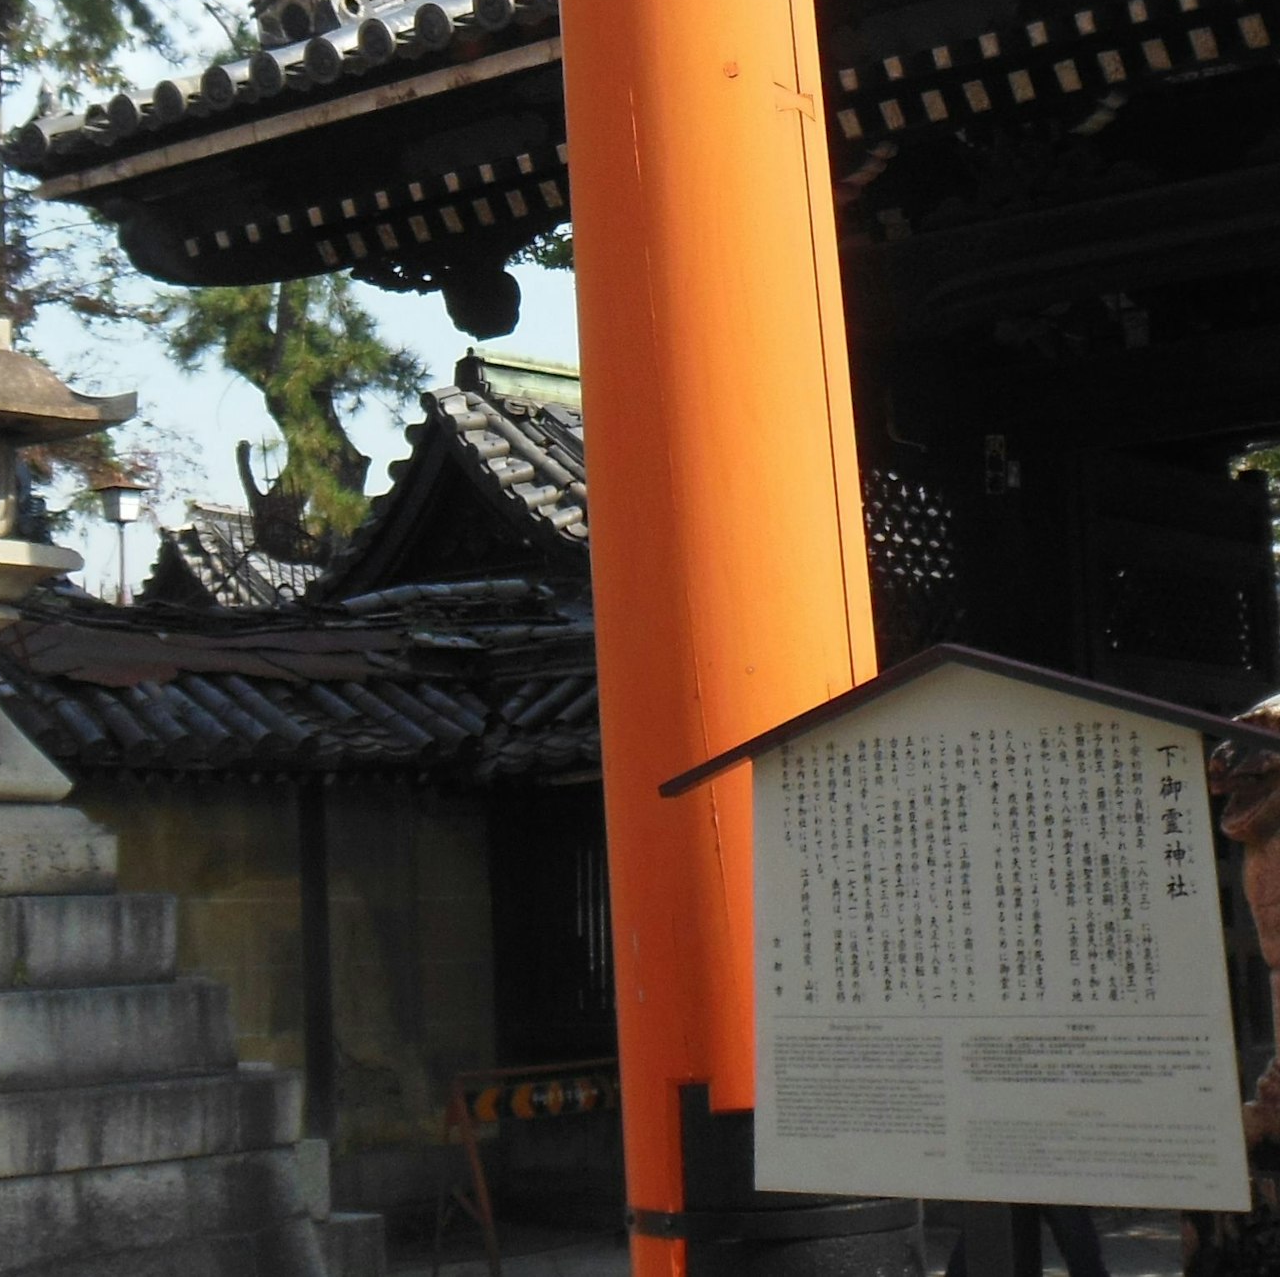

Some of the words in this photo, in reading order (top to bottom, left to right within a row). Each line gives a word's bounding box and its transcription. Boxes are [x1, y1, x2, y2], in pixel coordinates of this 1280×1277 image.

[1157, 745, 1189, 900] 下御霊神社
